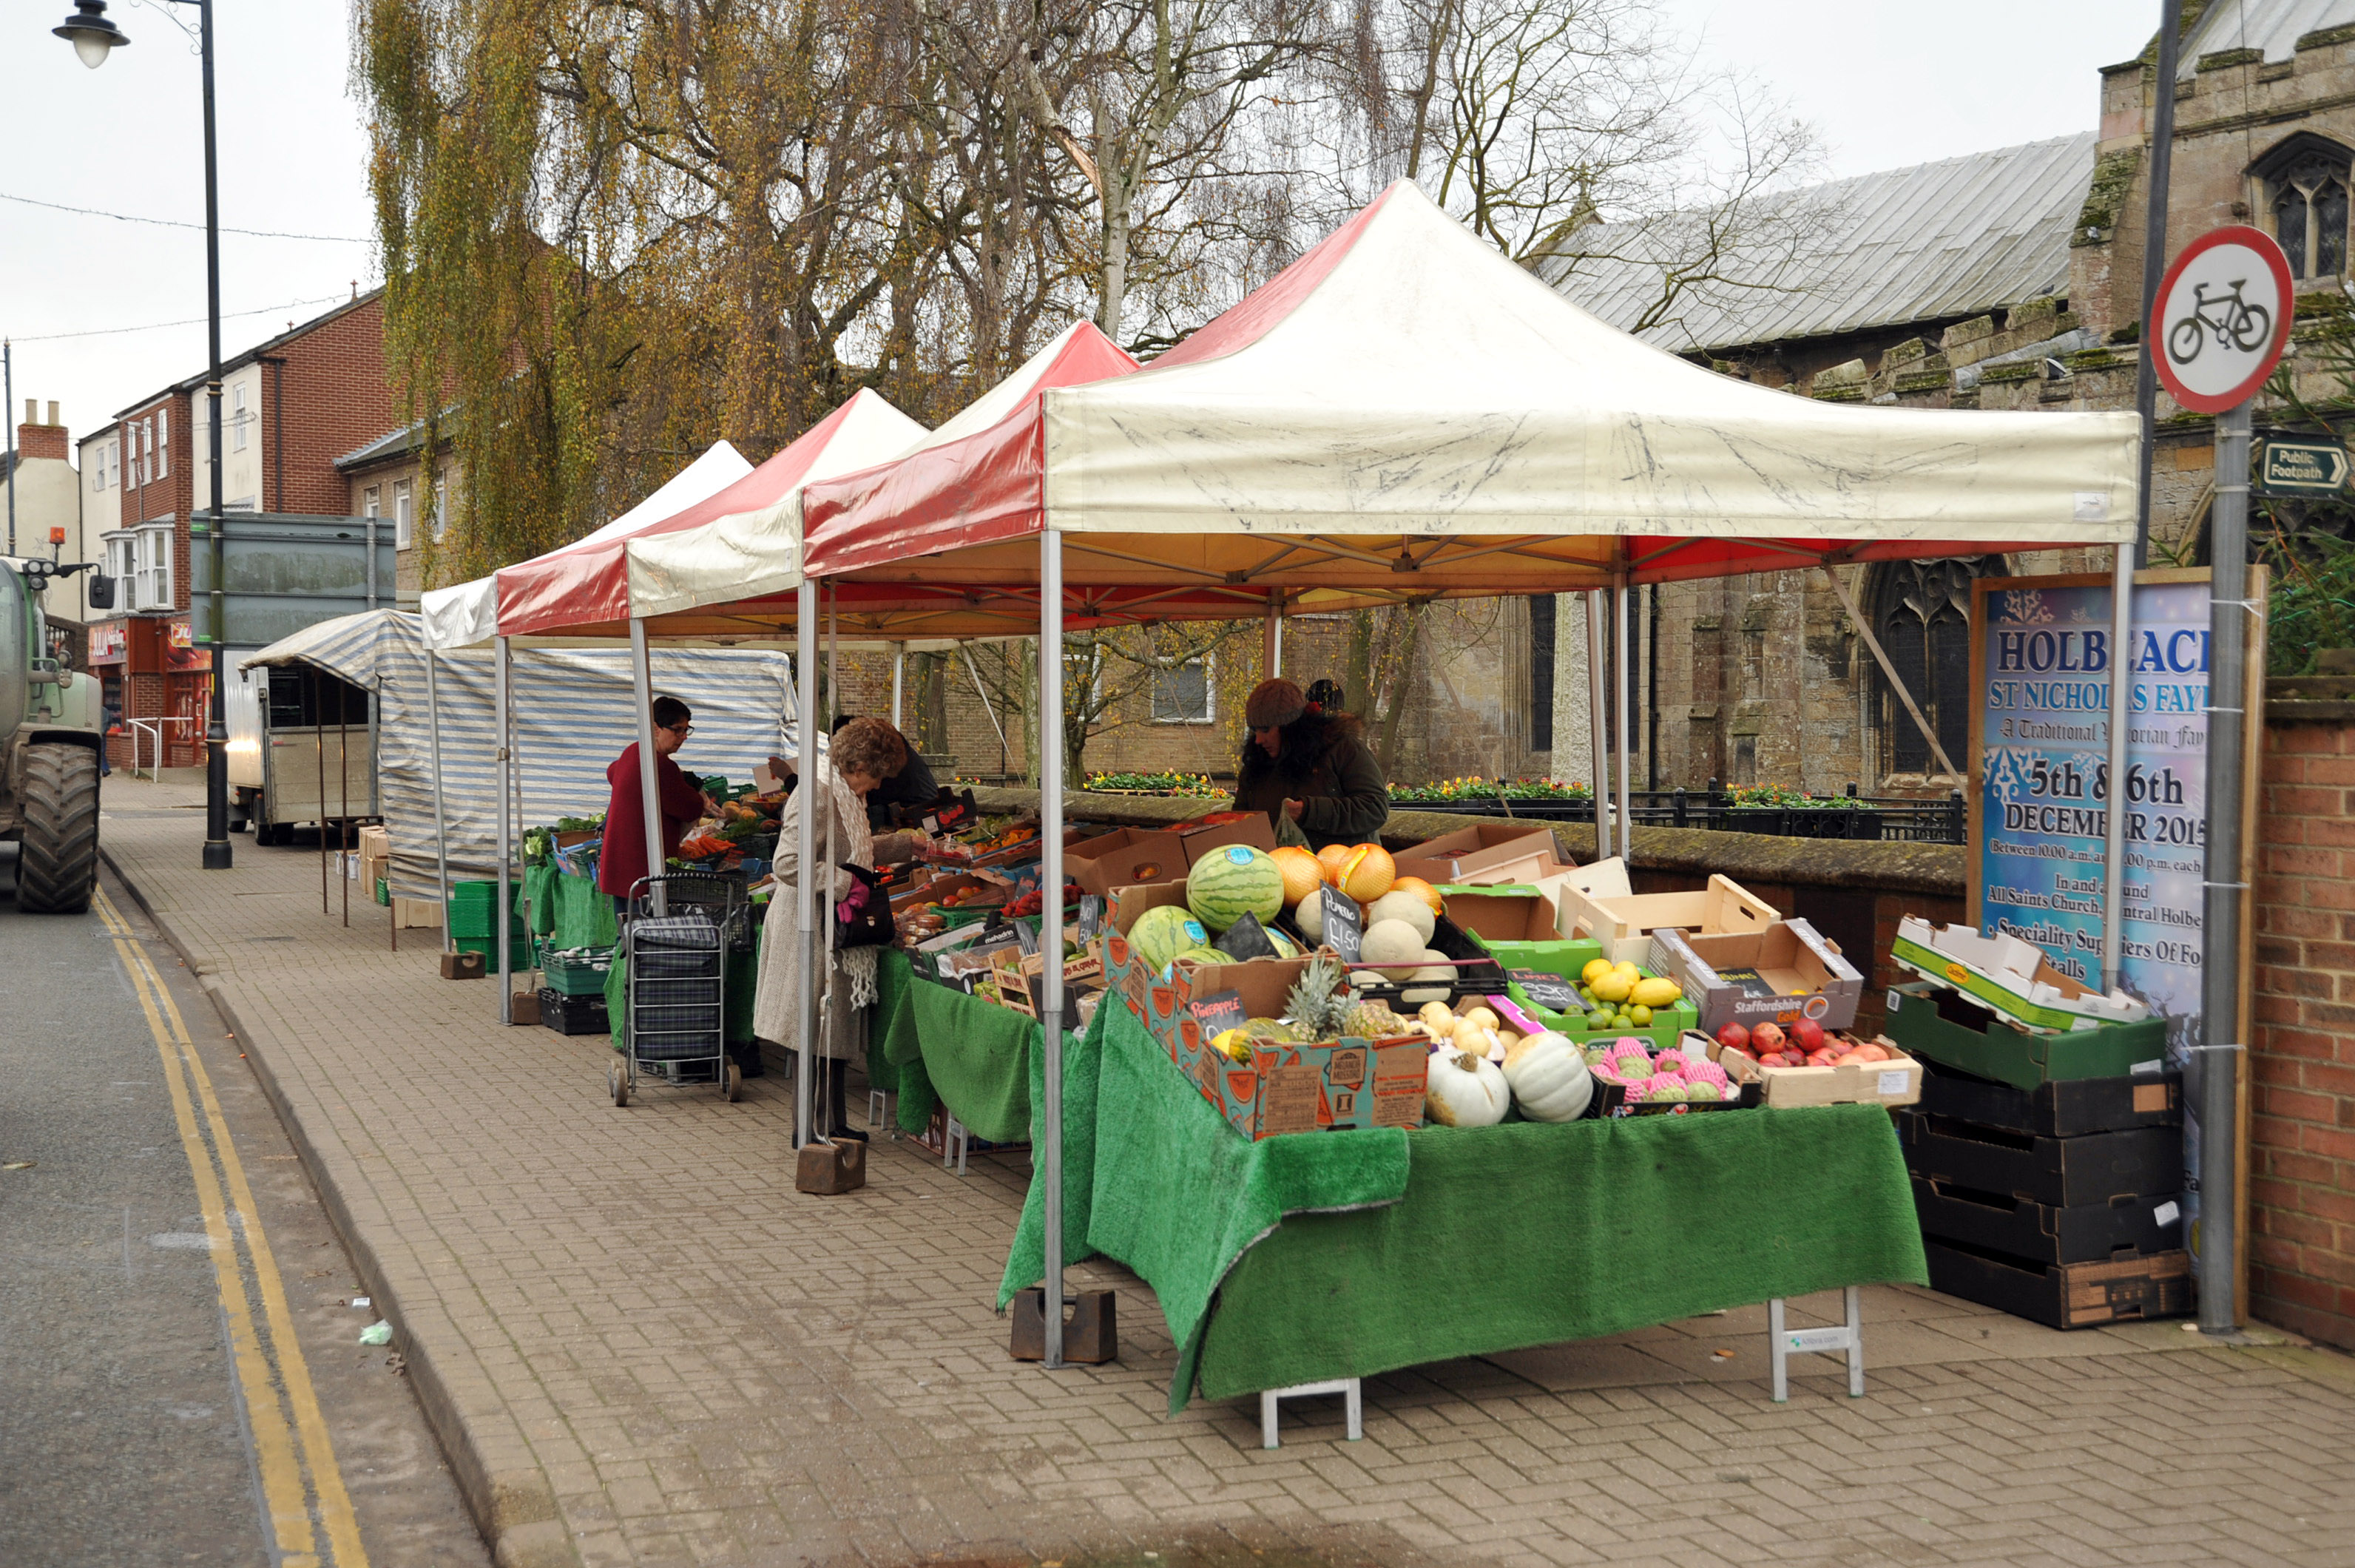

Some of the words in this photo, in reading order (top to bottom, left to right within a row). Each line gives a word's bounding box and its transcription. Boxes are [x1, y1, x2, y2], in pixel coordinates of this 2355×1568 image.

[2280, 450, 2315, 464] Public
[2271, 464, 2322, 479] Footpath
[1990, 681, 2018, 707] ST
[2023, 682, 2147, 711] NICHOLS
[2000, 718, 2014, 737] A
[2019, 719, 2097, 741] Traditional
[2030, 759, 2082, 797] 5th
[2092, 763, 2107, 800] &
[2126, 763, 2183, 804] 6th
[2004, 804, 2146, 840] DECEMBR
[2152, 816, 2206, 846] 2015
[1990, 839, 2035, 856] (Between
[2038, 845, 2066, 859] 10.00
[2069, 850, 2091, 862] a.m.
[2123, 853, 2143, 867] .00
[2146, 858, 2170, 871] p.m.
[2174, 859, 2201, 872] each
[2056, 874, 2068, 890] In
[2072, 878, 2096, 893] and
[1990, 887, 2005, 902] All
[2008, 889, 2048, 908] Saints
[984, 930, 1014, 944] mehadrin
[1999, 919, 2072, 953] Speciality
[2076, 929, 2151, 958] Supiers
[2157, 941, 2177, 961] Of
[1734, 999, 1802, 1013] Staffordshire
[1777, 1010, 1801, 1024] Gold
